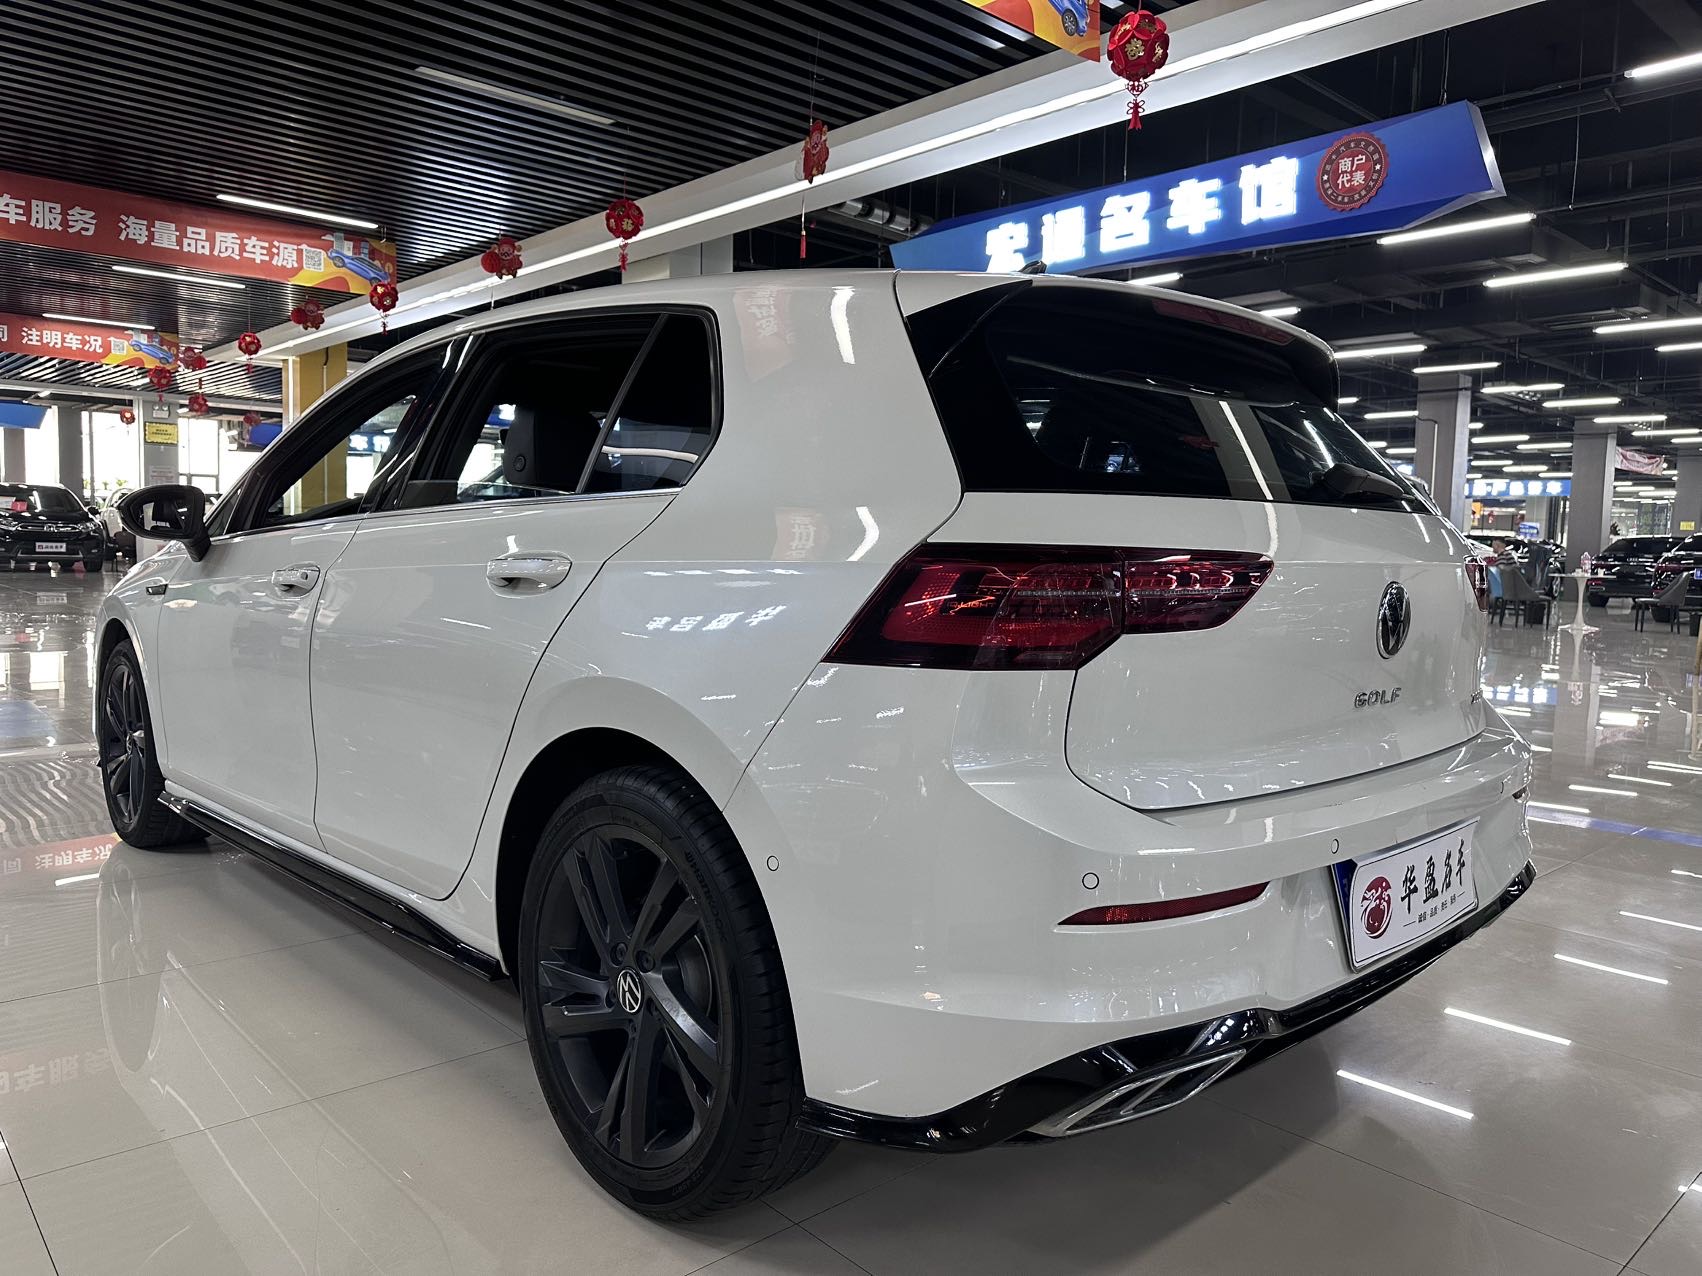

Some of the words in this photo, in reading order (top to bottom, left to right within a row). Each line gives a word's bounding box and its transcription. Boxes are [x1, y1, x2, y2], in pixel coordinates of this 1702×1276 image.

[1338, 154, 1366, 174] 商户
[1337, 170, 1366, 189] 代表
[118, 213, 299, 270] 海量品质车源
[21, 327, 104, 353] 注明车况
[1354, 687, 1402, 709] GOLF
